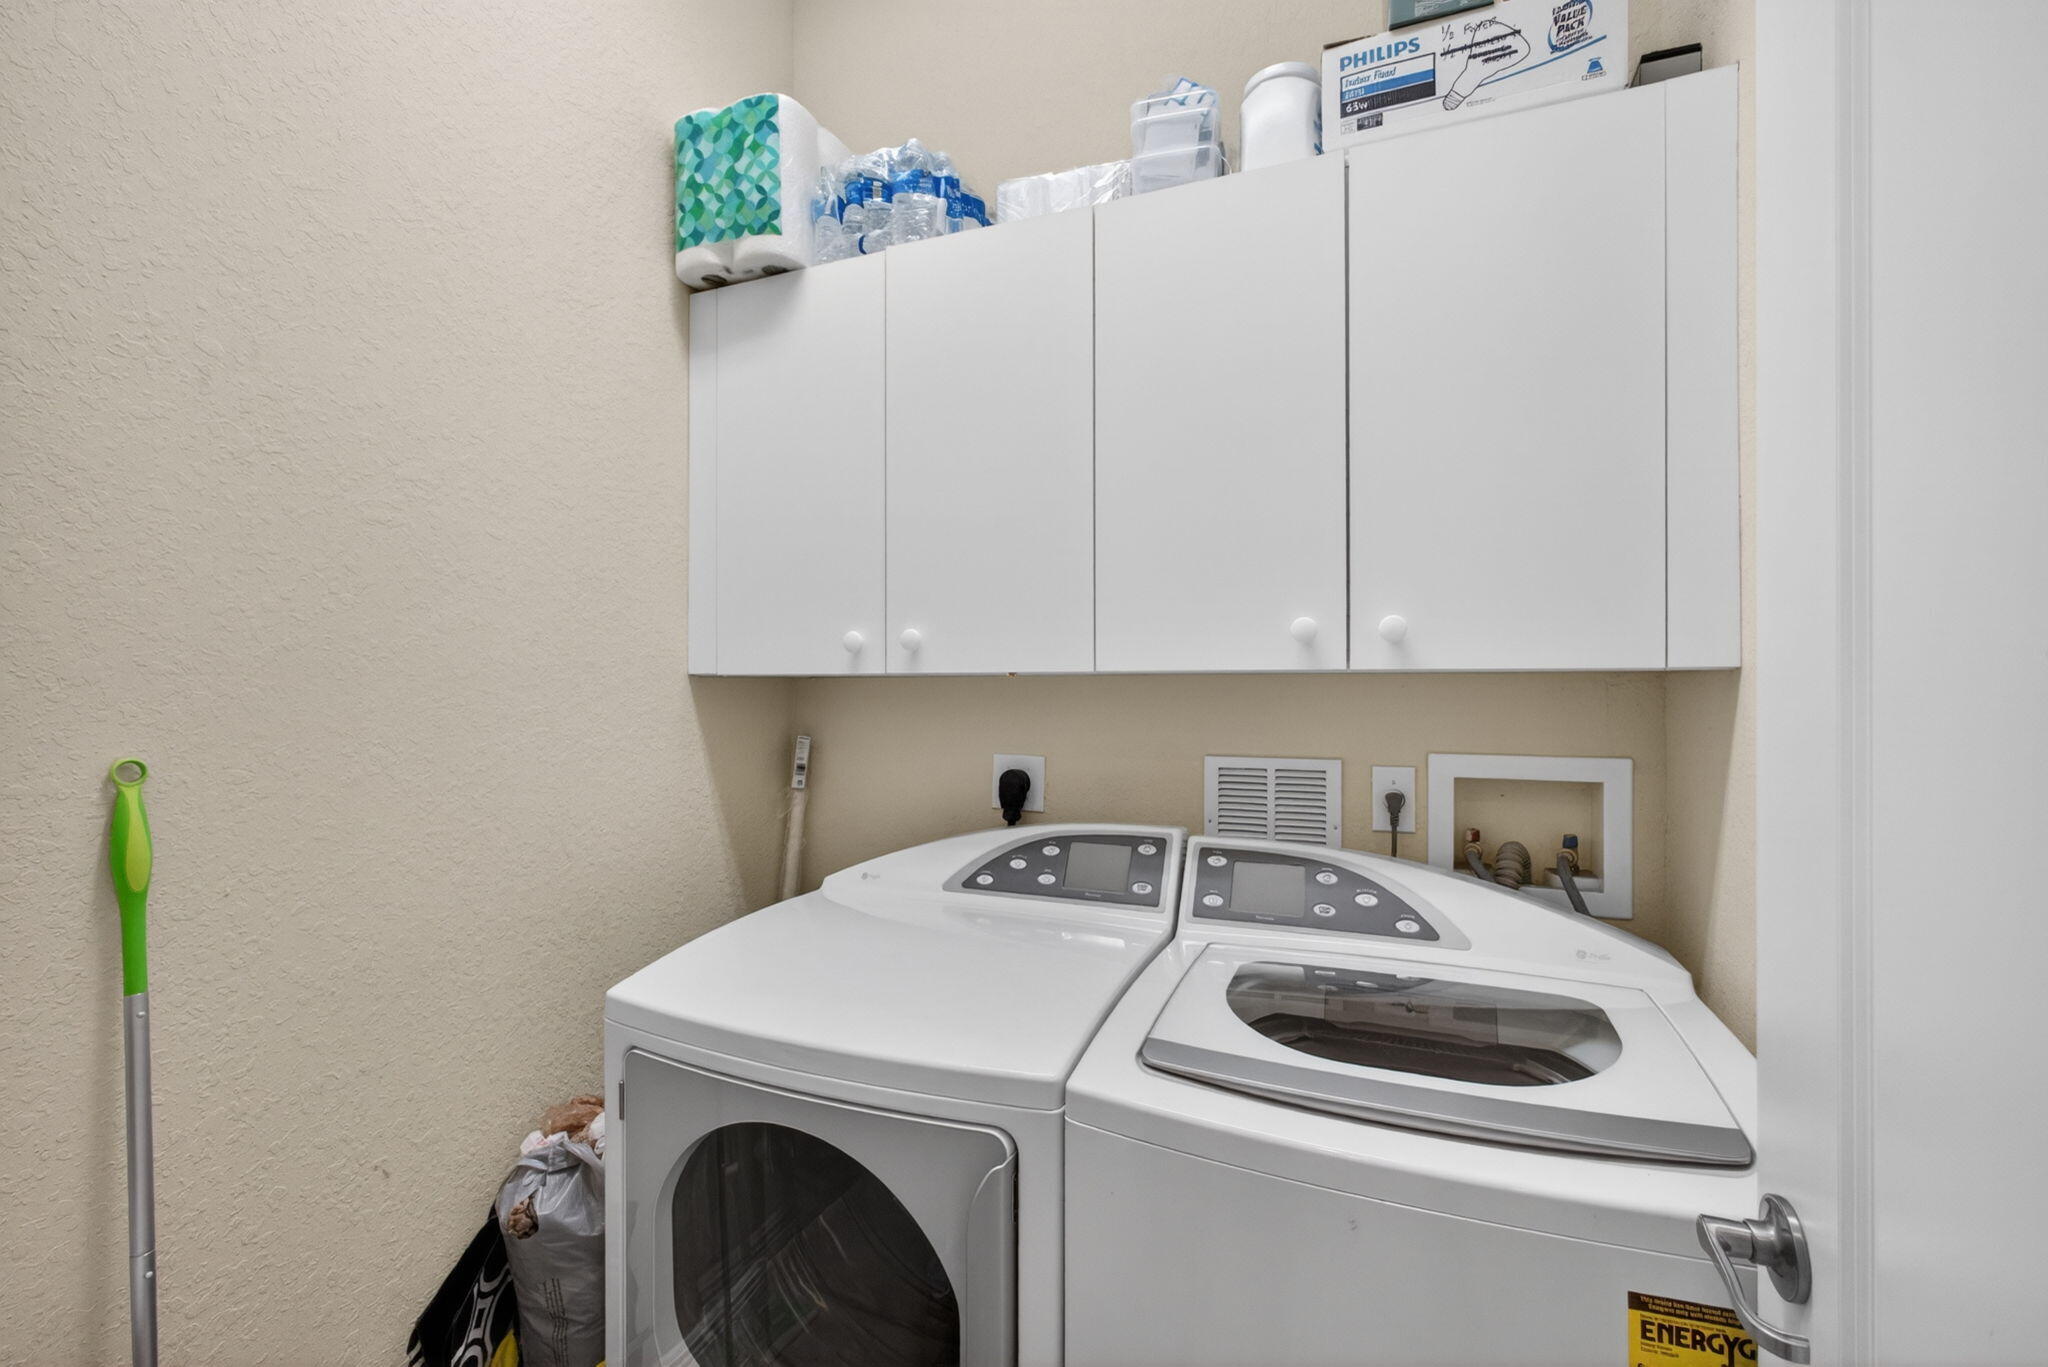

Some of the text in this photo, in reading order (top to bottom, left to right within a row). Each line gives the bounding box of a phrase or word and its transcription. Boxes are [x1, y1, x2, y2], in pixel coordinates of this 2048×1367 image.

[1553, 5, 1588, 27] VALUE
[1556, 16, 1586, 38] PACK
[1339, 36, 1421, 72] PHILIPS
